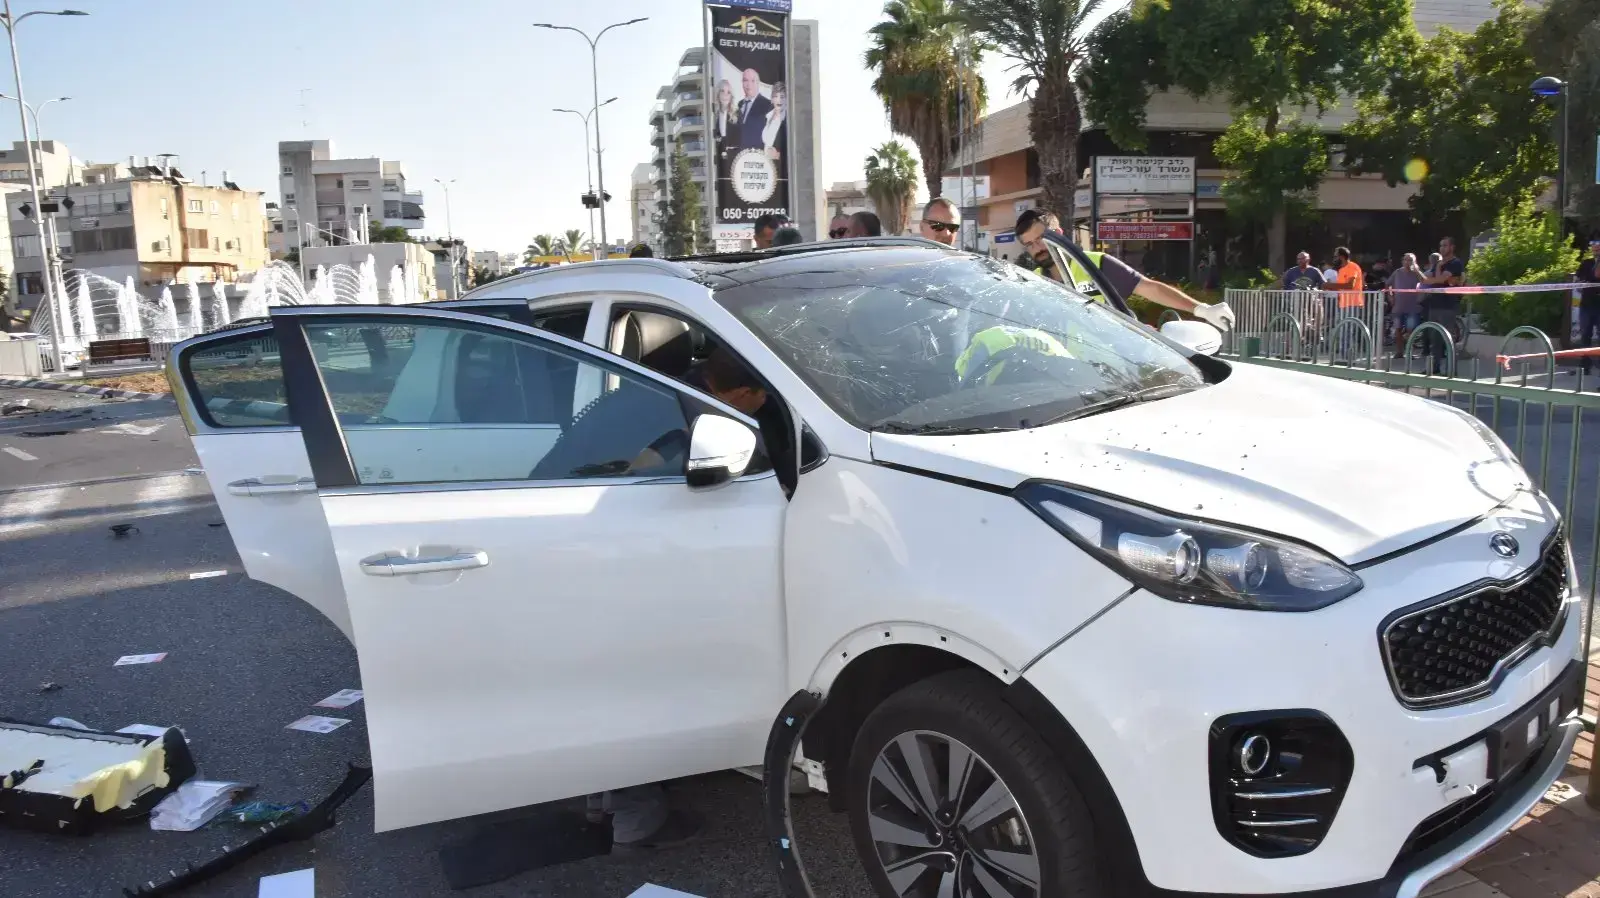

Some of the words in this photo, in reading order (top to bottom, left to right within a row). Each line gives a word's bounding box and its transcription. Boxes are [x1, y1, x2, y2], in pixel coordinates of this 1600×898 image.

[720, 38, 739, 47] GET
[740, 42, 781, 52] MAXIMUM
[744, 161, 764, 169] אמינות
